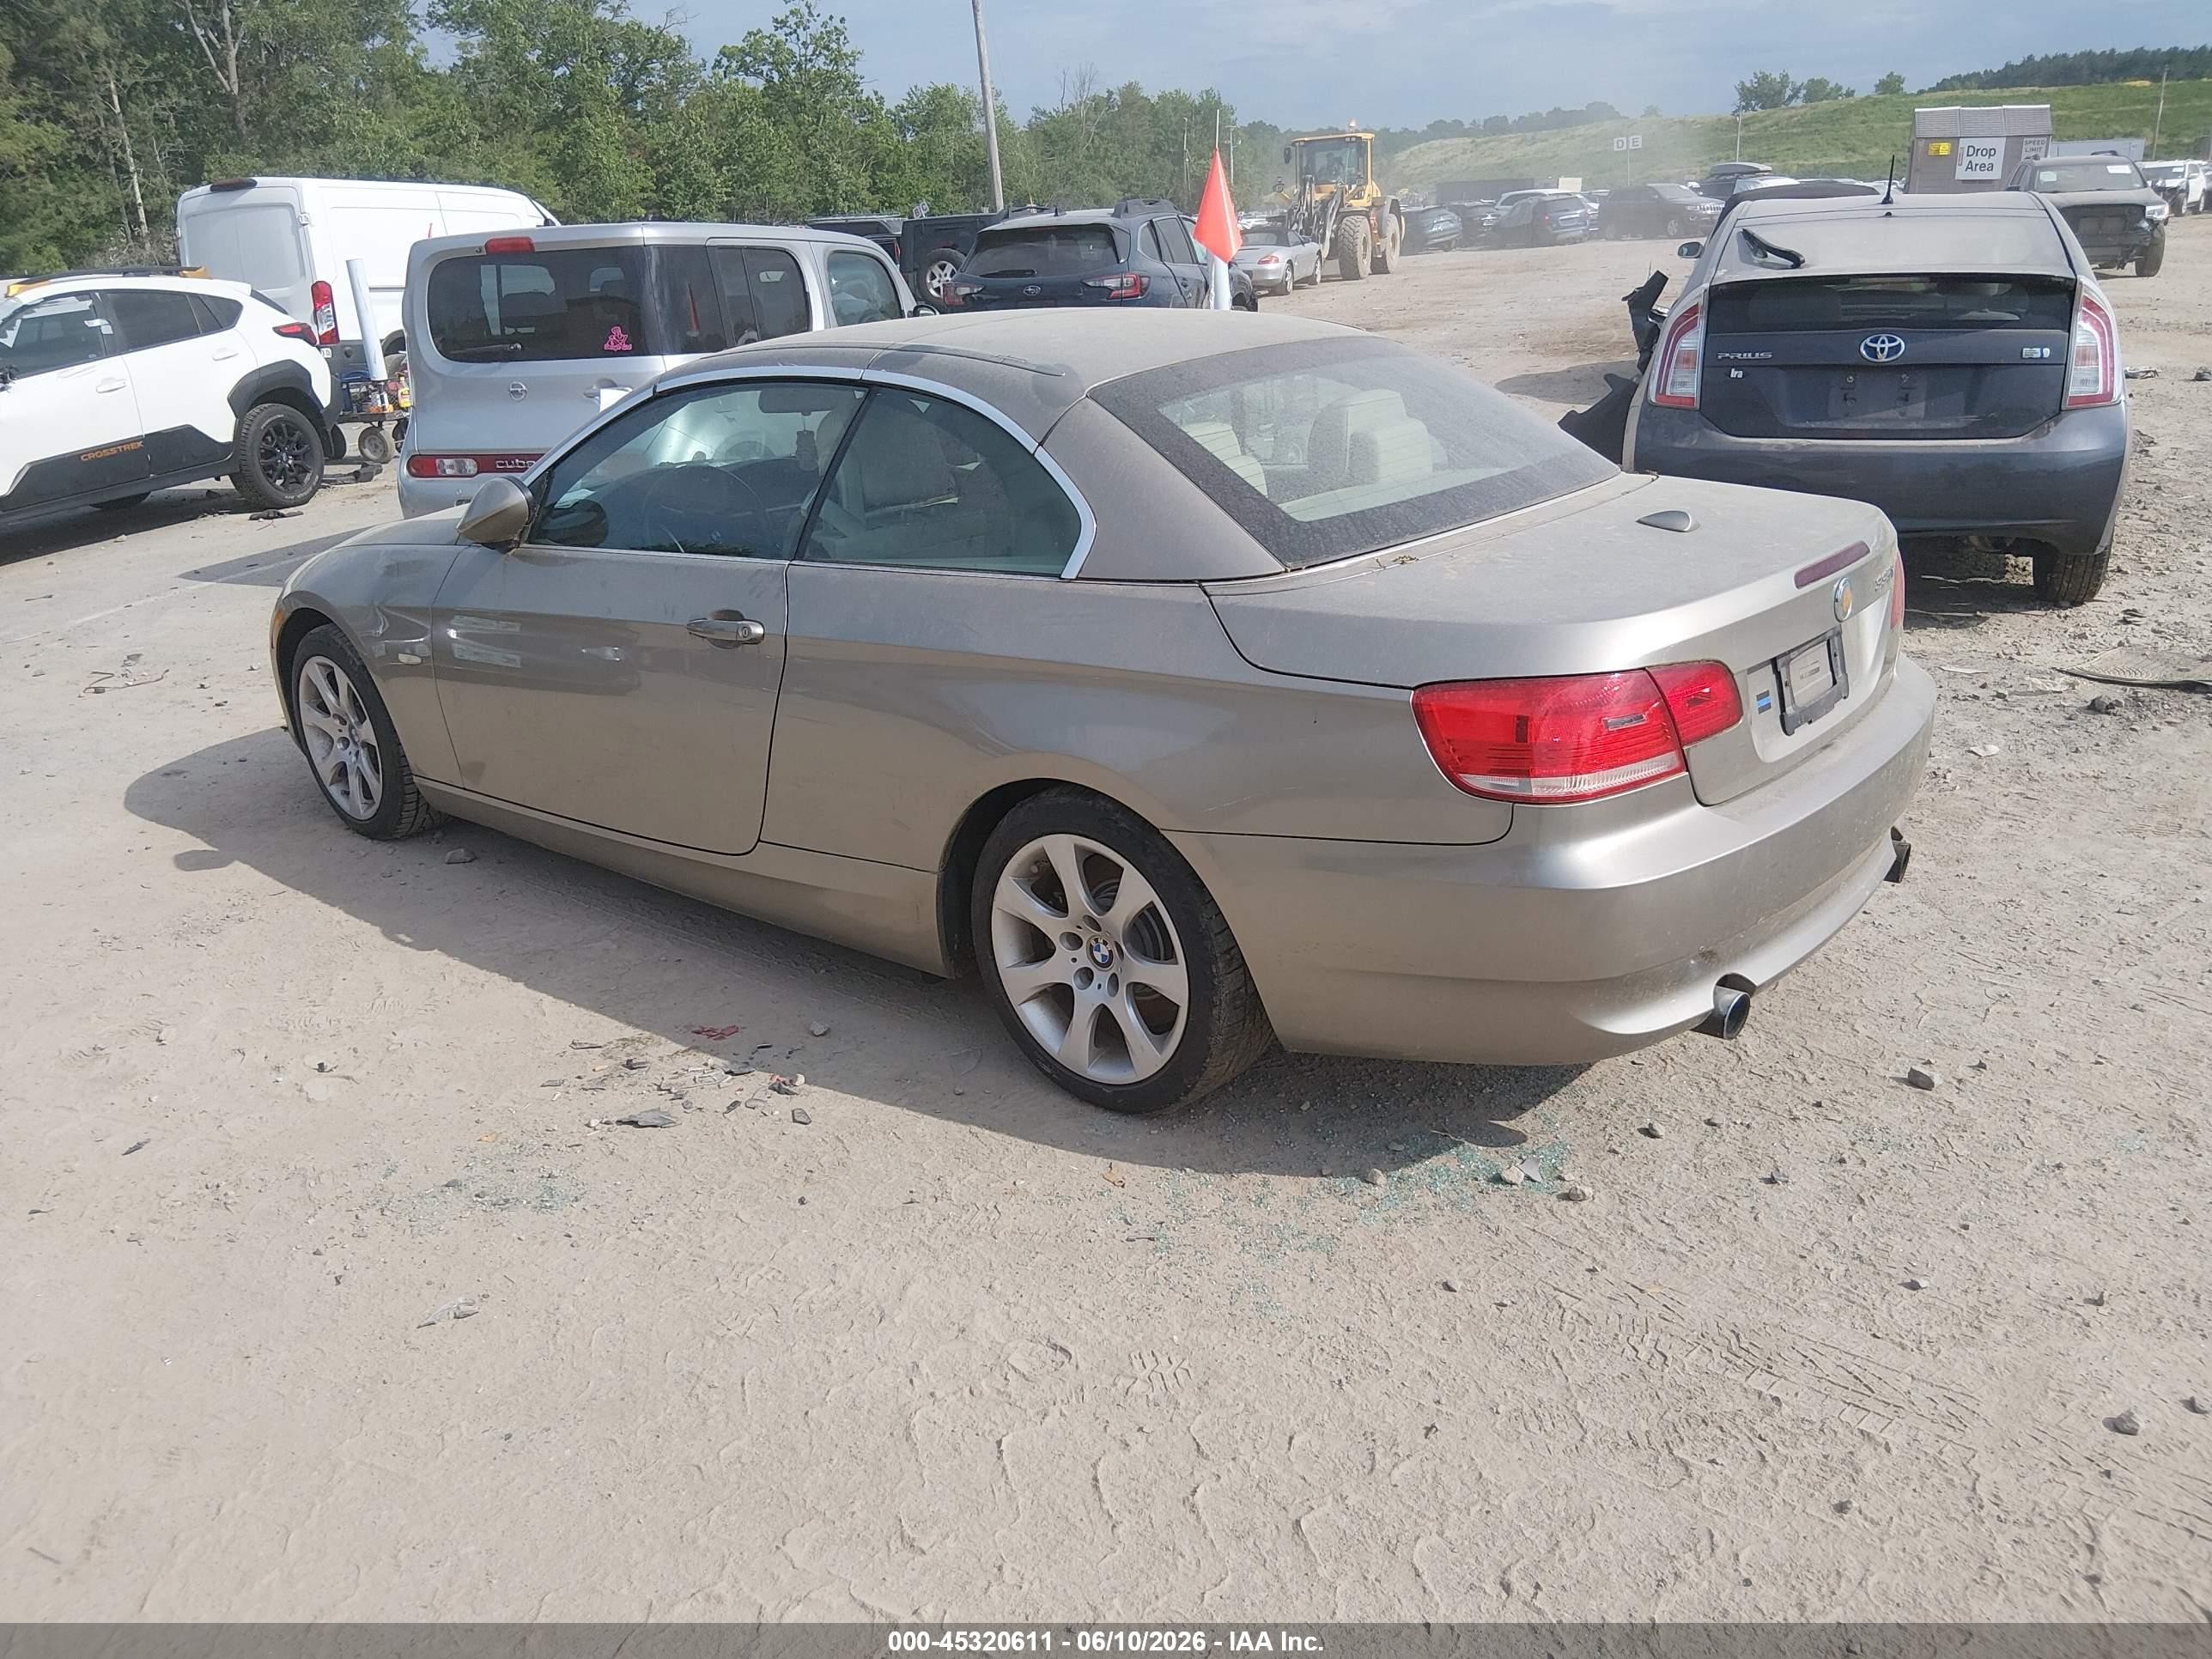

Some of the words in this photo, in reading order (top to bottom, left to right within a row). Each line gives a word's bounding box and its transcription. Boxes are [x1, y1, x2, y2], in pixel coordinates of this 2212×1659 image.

[1966, 145, 1996, 159] Drop
[1965, 160, 1994, 172] Area
[1717, 351, 1772, 360] PRIUS
[81, 441, 144, 462] CROSSTREK
